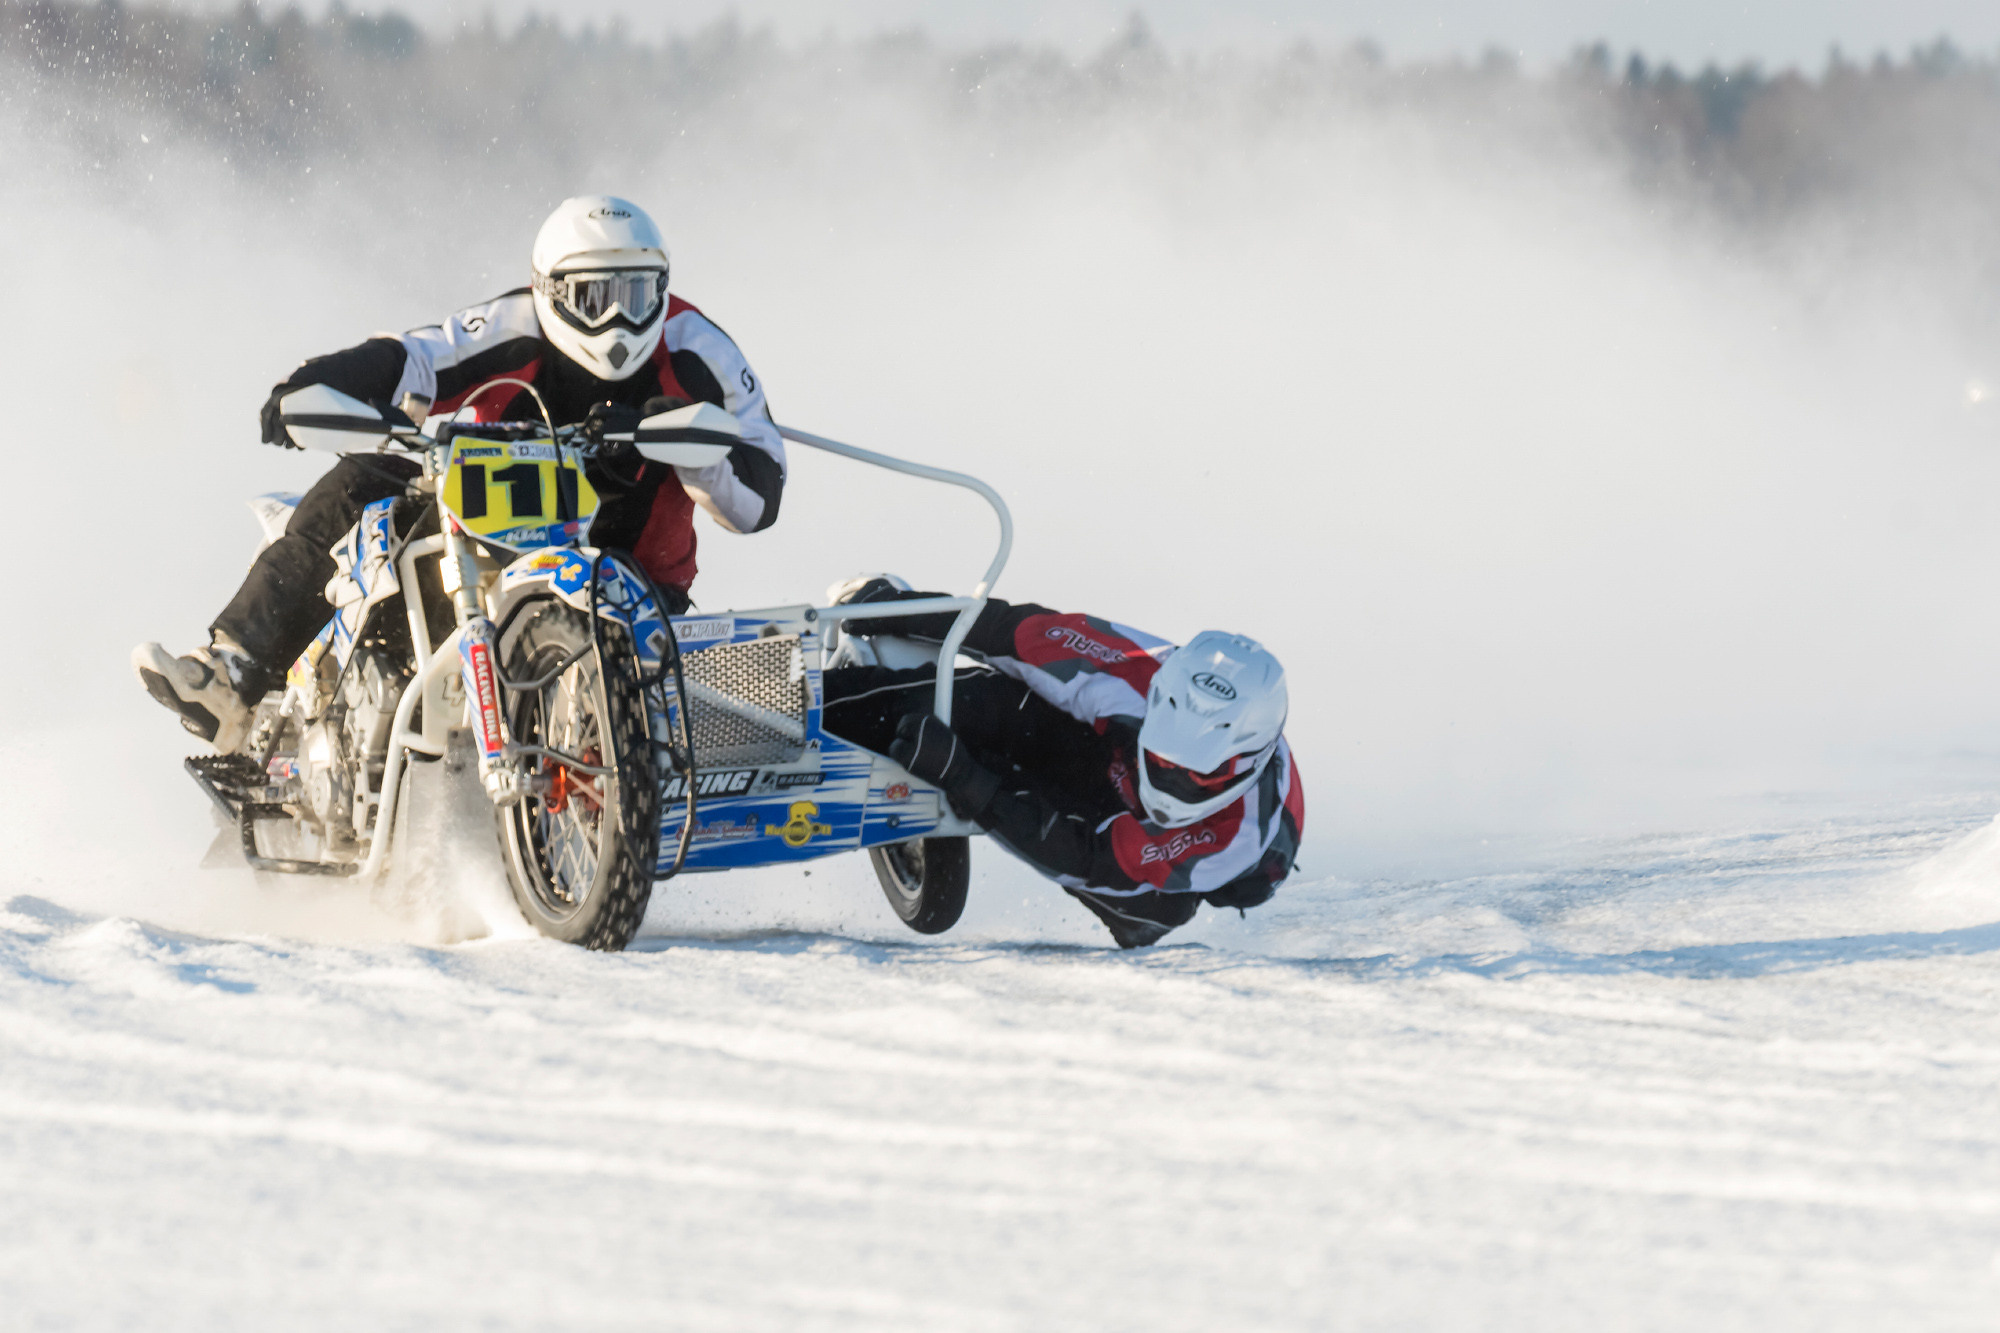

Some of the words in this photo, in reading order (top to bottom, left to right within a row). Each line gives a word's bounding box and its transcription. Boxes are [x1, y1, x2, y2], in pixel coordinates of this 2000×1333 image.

[474, 650, 493, 707] RACING
[1199, 673, 1234, 698] Arai
[483, 708, 500, 743] BIKE
